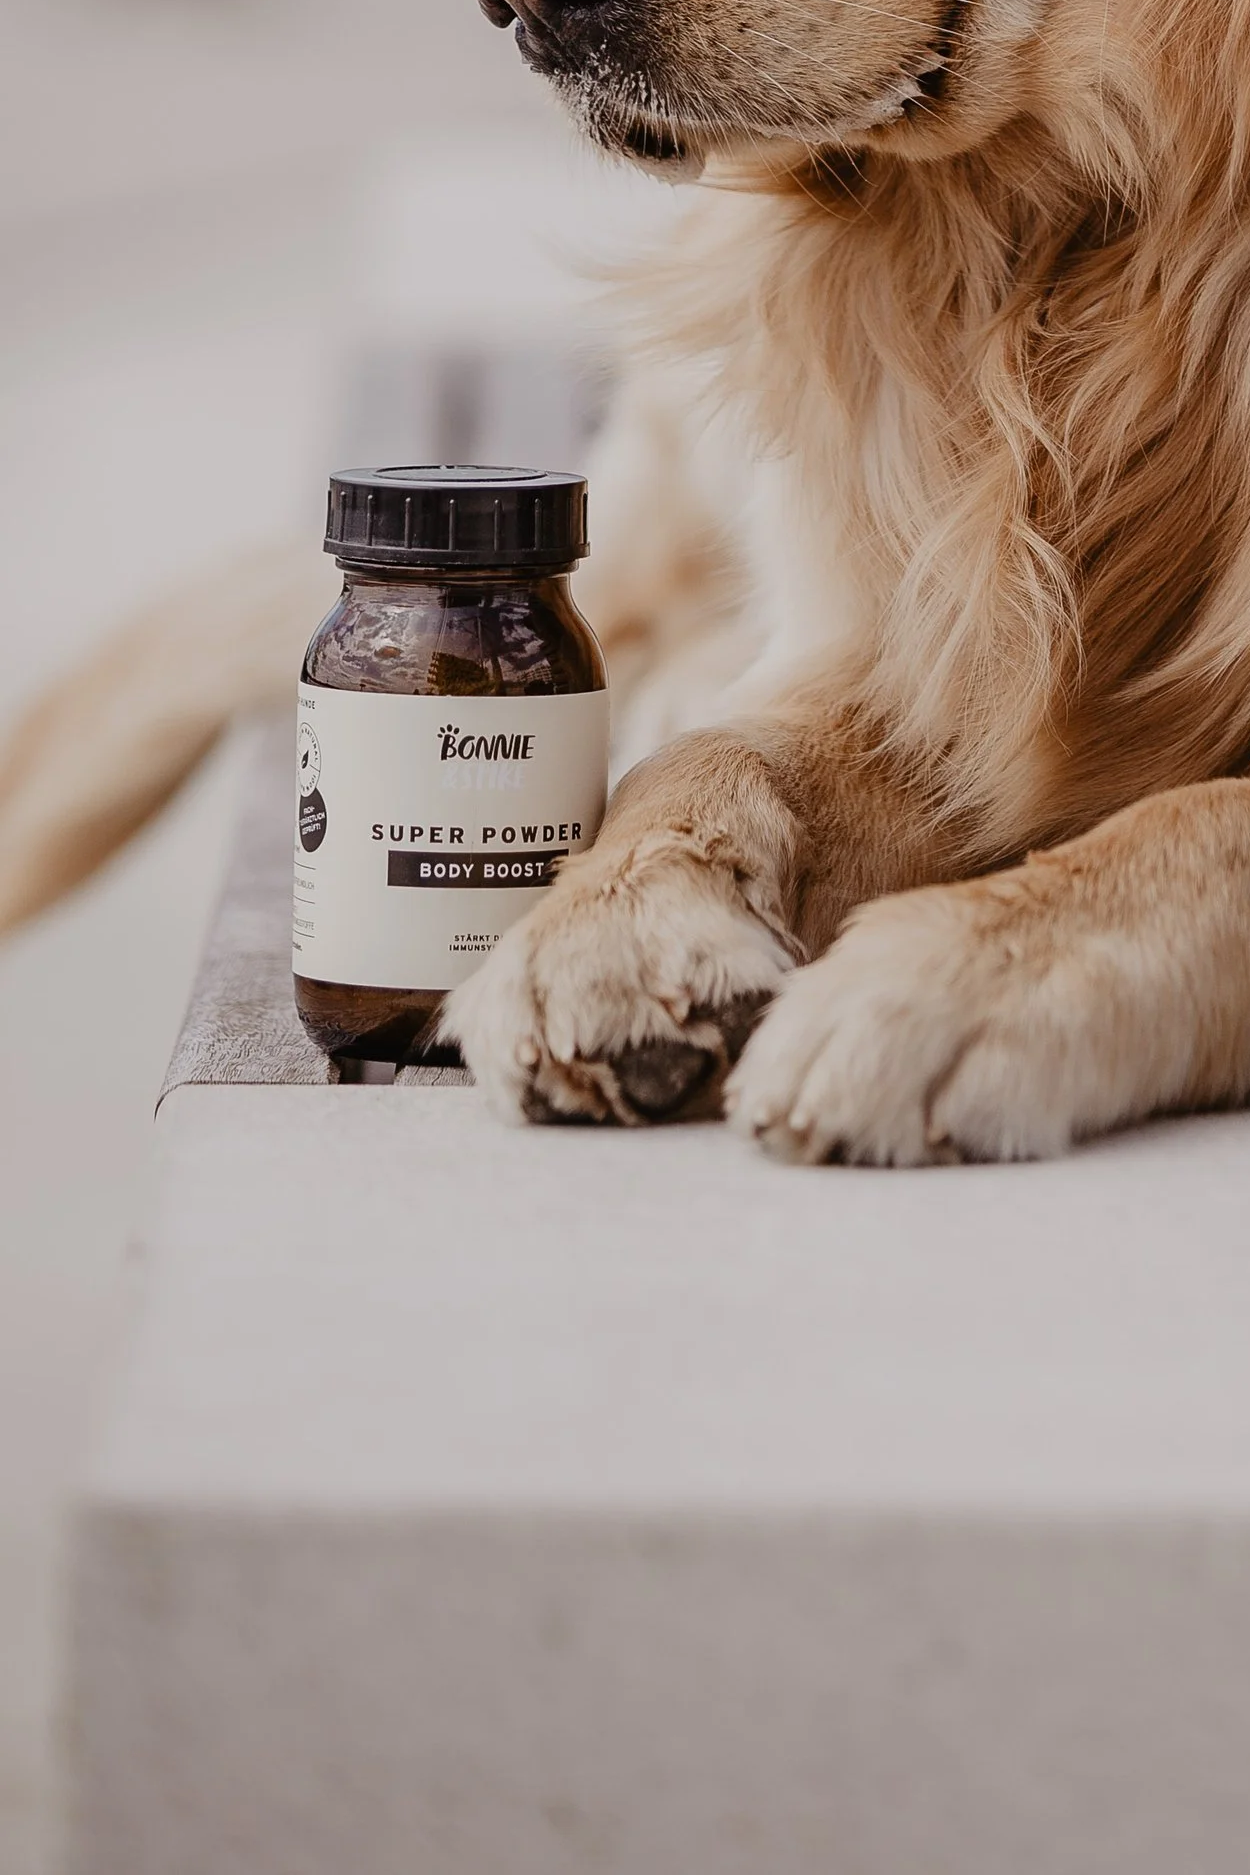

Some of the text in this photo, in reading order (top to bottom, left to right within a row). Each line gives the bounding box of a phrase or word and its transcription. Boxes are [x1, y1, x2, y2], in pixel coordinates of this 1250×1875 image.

[440, 732, 536, 761] BONNIE
[371, 822, 583, 844] SUPER POWDER
[420, 862, 545, 878] BODY BOOST
[449, 944, 495, 952] IMMUNSY
